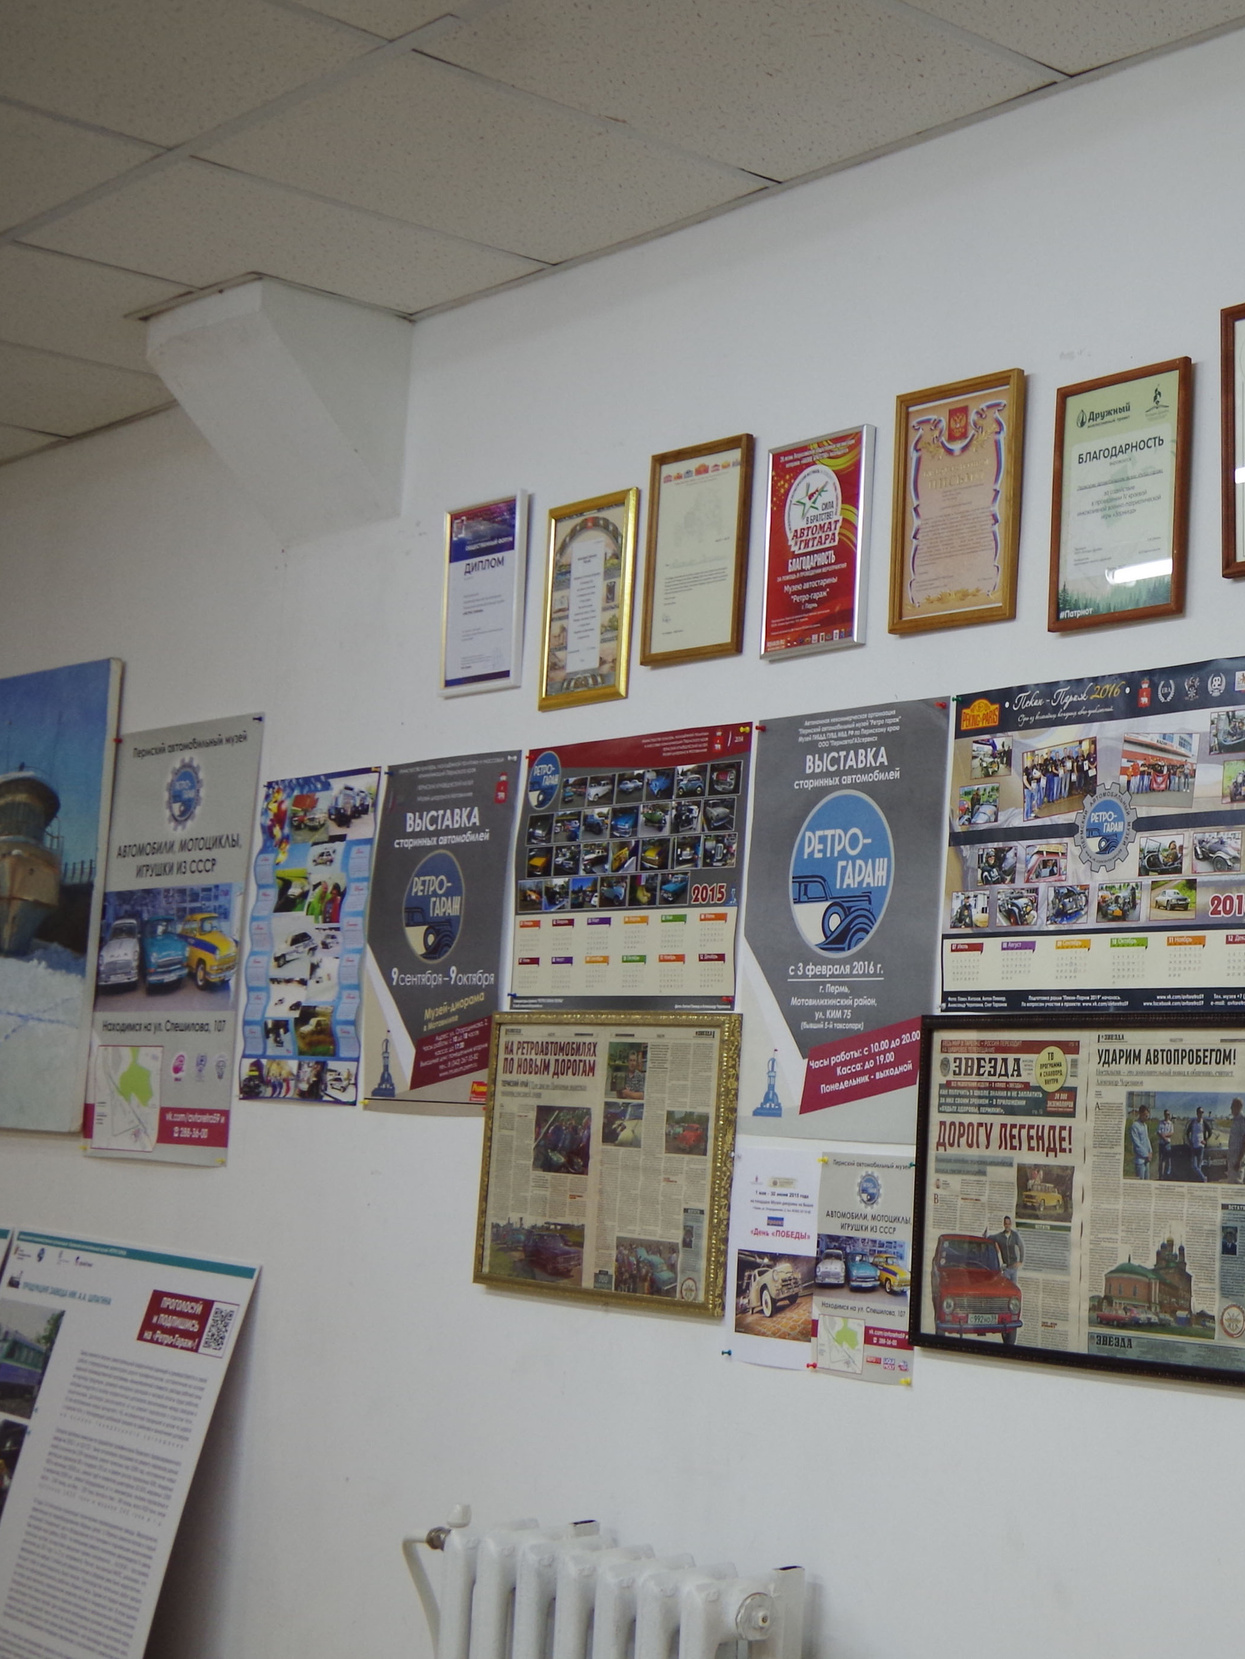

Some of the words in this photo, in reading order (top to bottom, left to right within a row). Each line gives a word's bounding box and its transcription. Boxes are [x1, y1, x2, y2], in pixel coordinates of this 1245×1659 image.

[1088, 402, 1131, 423] Дружный
[1078, 435, 1165, 465] БЛАГОДАРНОСТЬ
[821, 500, 834, 511] СИЛА
[792, 520, 839, 540] АВТОМАТ
[464, 556, 504, 576] ДИПЛОМ
[788, 550, 835, 572] БЛАГОДАРНОСТЬ
[784, 584, 802, 594] Музею
[803, 577, 838, 589] автостарины
[1060, 607, 1093, 619] #Патриот
[806, 746, 888, 774] ВЫСТАВКА
[794, 776, 839, 790] старинных
[842, 767, 900, 784] автомобилей
[406, 807, 480, 832] ВЫСТАВКА
[1091, 811, 1117, 823] РЕТРО-
[1103, 821, 1123, 833] ГАРАЖ
[117, 840, 177, 859] АВТОМОБИЛИ,
[178, 833, 242, 853] МОТОЦИКЛЫ,
[394, 839, 437, 849] старинных
[439, 829, 489, 845] автомобилей
[804, 828, 872, 858] РЕТРО-
[136, 862, 174, 879] ИГРУШКИ
[176, 862, 186, 875] ИЗ
[190, 858, 216, 874] СССР
[836, 858, 887, 889] ГАРАЖ
[412, 876, 452, 896] РЕТРО-
[692, 884, 726, 904] 2015
[430, 897, 461, 917] ГАРАЖ
[392, 967, 398, 985] 9
[399, 970, 442, 988] сентября
[450, 966, 457, 984] 9
[457, 970, 494, 988] октября
[789, 966, 794, 975] с
[797, 964, 803, 975] 3
[806, 963, 850, 977] февраля
[853, 961, 874, 975] 2016
[877, 963, 883, 974] г.
[826, 983, 850, 994] Пермь,
[815, 1010, 824, 1019] ул.
[826, 1010, 841, 1019] КИМ
[843, 1010, 851, 1018] 75
[505, 1040, 514, 1055] НА
[516, 1041, 597, 1058] РЕТРОАВТОМОБИЛЯХ
[809, 1058, 829, 1069] Часы
[831, 1050, 862, 1064] работы:
[864, 1047, 868, 1055] с
[870, 1039, 889, 1052] 10.00
[890, 1039, 900, 1047] до
[901, 1030, 920, 1044] 20.00
[1097, 1049, 1141, 1067] УДАРИМ
[1145, 1048, 1236, 1065] АВТОПРОБЕГОМ!
[503, 1058, 514, 1074] ПО
[517, 1058, 549, 1075] НОВЫМ
[552, 1059, 595, 1078] ДОРОГАМ
[837, 1063, 863, 1076] Касса:
[864, 1061, 874, 1069] до
[876, 1052, 895, 1065] 19.00
[953, 1057, 1022, 1078] ЗВЕЗДА
[820, 1074, 869, 1094] Понедельник
[876, 1061, 912, 1079] выходной
[936, 1121, 993, 1151] ДОРОГУ
[998, 1123, 1072, 1158] ЛЕГЕНДЕ!
[751, 1229, 769, 1237] «День
[771, 1230, 810, 1240] «ПОБЕДЫ»
[841, 1223, 868, 1232] ИГРУШКИ
[879, 1226, 896, 1235] СССР
[161, 1297, 202, 1314] ПРОГОЛОСУЙ
[1096, 1334, 1132, 1349] ЗВЕЗДА
